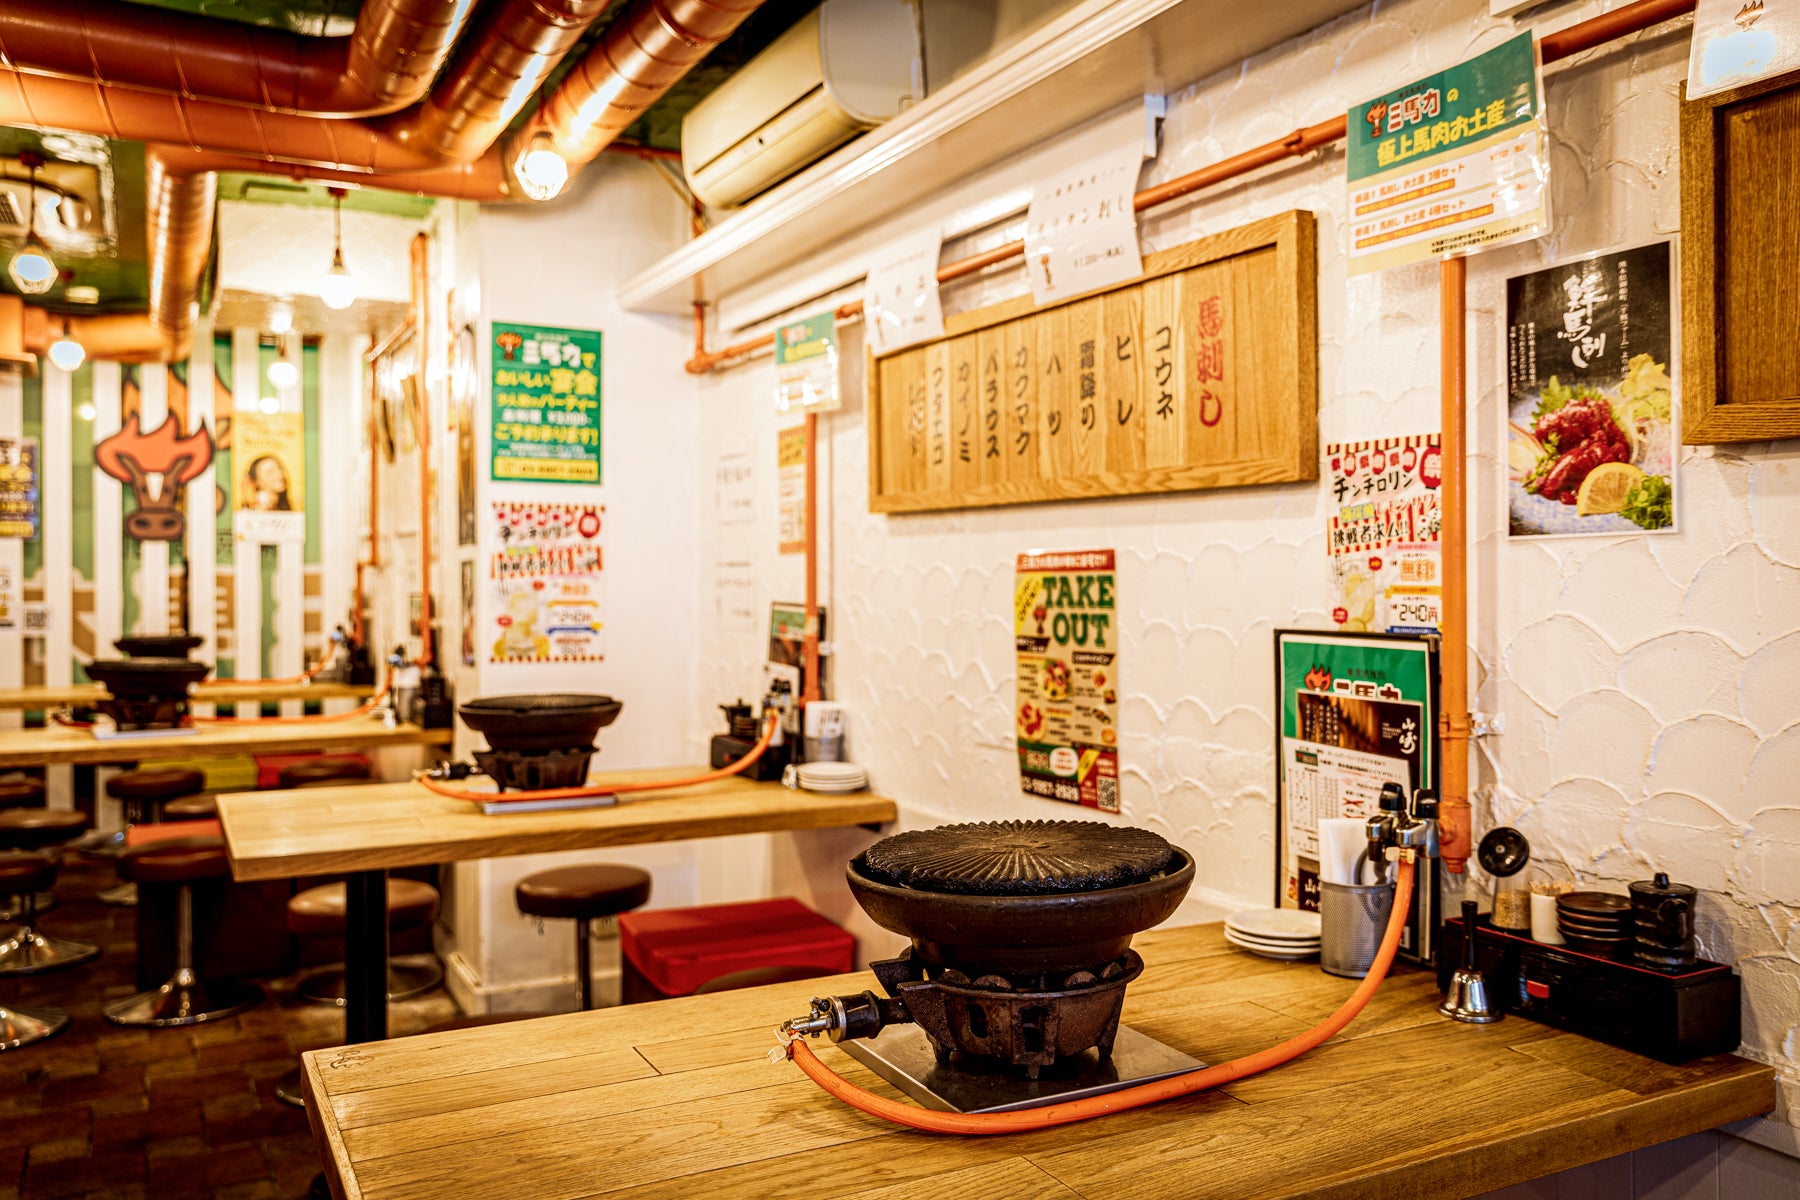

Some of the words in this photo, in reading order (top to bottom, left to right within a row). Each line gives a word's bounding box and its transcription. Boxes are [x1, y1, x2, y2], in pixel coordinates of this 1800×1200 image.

[1376, 98, 1507, 168] 極上馬肉お土産
[1388, 88, 1441, 133] 三馬力
[1446, 87, 1459, 103] の
[1116, 336, 1134, 426] ヒレ
[1155, 326, 1174, 421] コウネ
[1197, 294, 1224, 428] 馬刺し
[1046, 353, 1062, 436] ハツ
[1333, 471, 1413, 502] チンチロリン
[1042, 575, 1115, 609] TAKE
[1399, 603, 1438, 622] 240円
[1052, 612, 1110, 648] OUT
